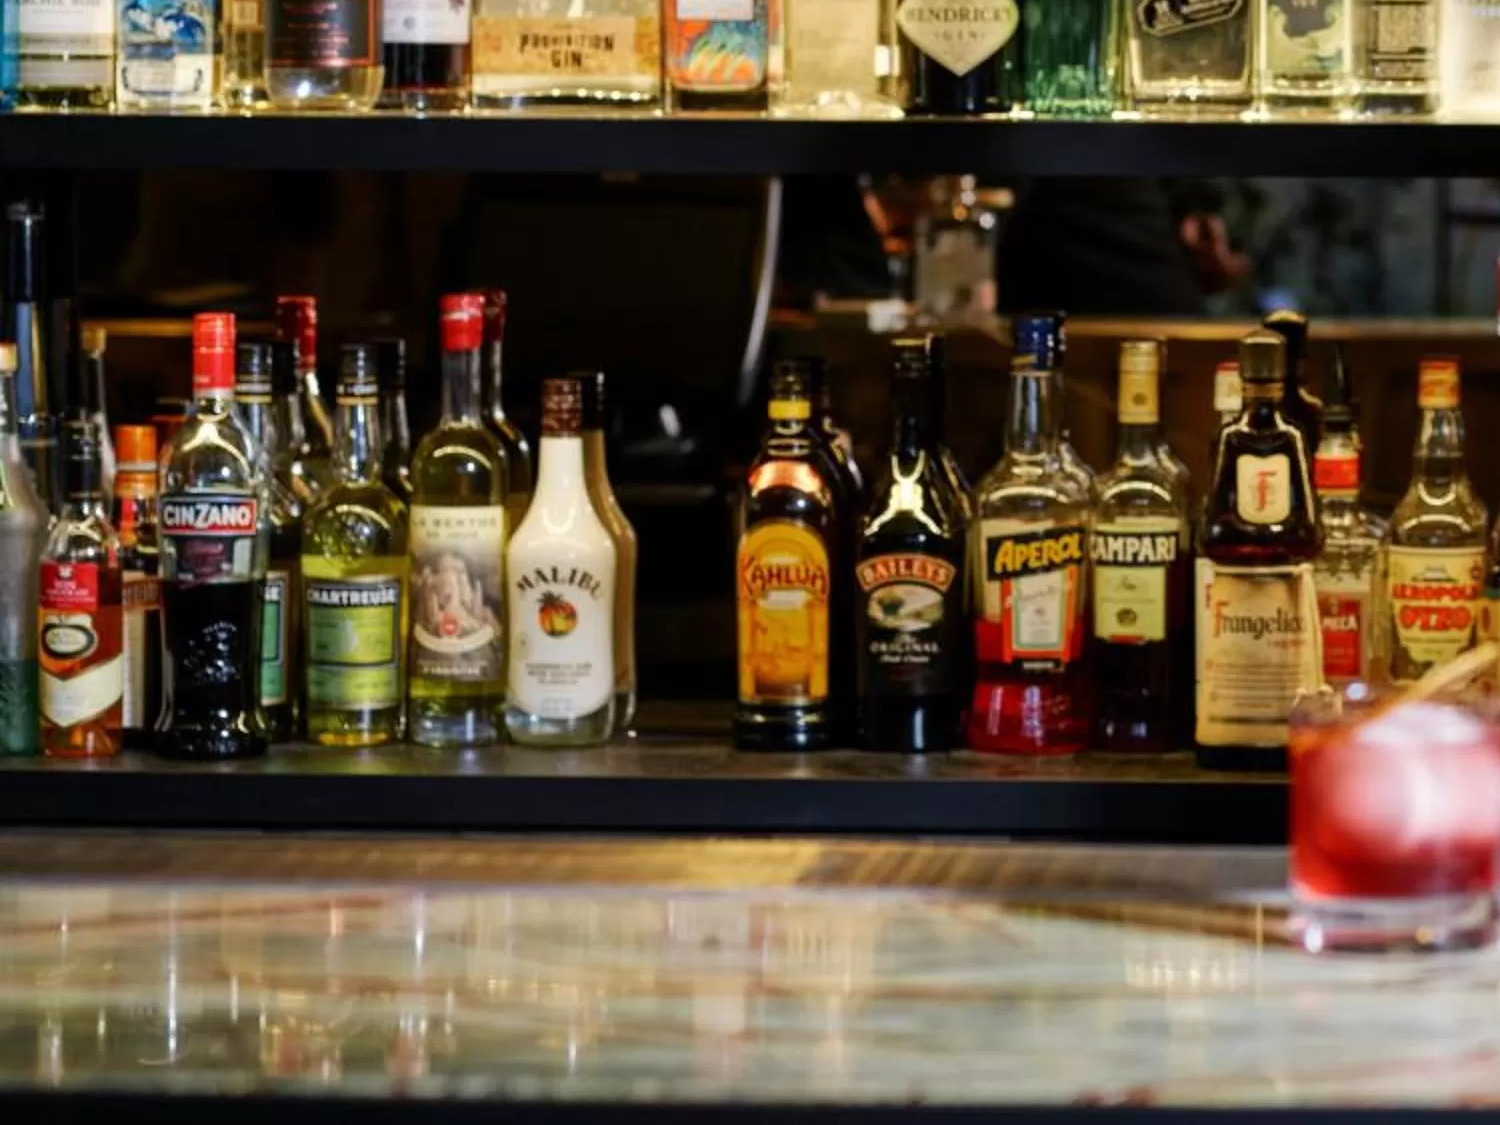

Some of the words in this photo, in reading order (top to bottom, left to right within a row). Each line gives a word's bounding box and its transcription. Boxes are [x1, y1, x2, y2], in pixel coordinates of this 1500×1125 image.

[518, 34, 615, 53] PROHIBITION
[550, 49, 584, 68] GIN
[162, 505, 252, 527] CINZANO
[994, 531, 1082, 573] APEROL
[862, 557, 949, 586] BAILEYS
